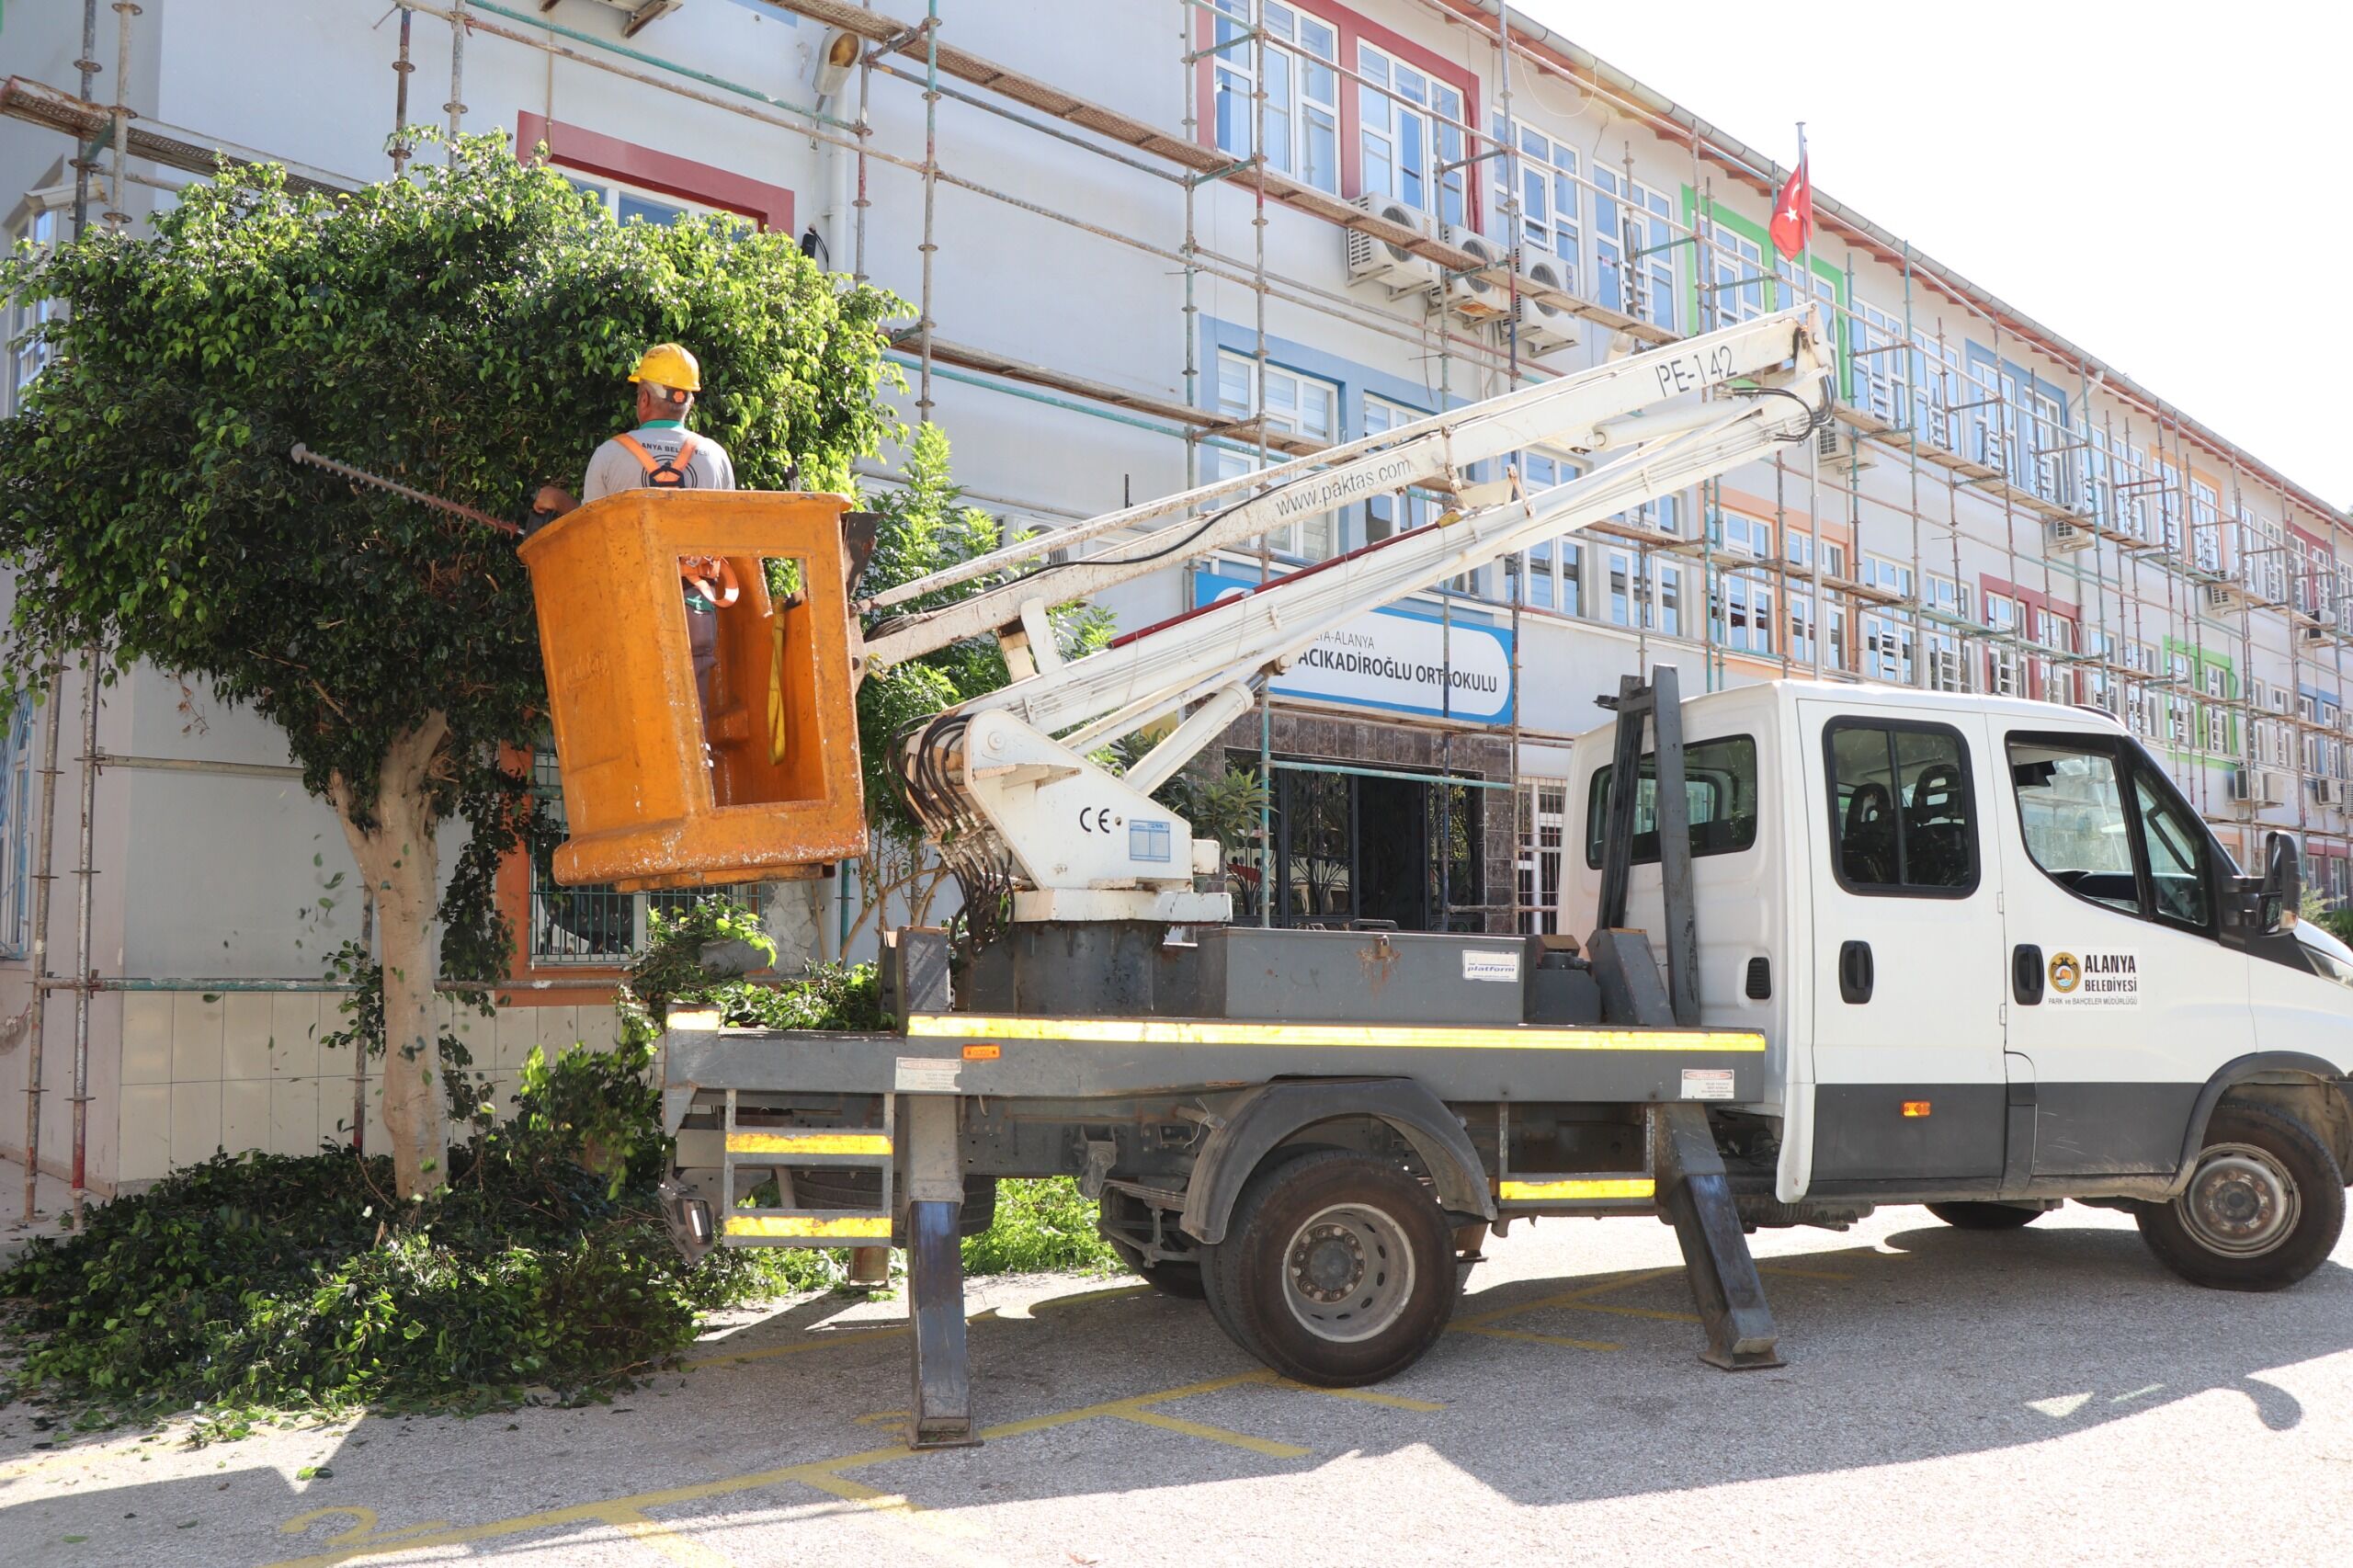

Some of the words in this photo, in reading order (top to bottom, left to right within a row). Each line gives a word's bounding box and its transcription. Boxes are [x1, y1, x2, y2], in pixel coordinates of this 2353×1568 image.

[1655, 346, 1737, 397] PE-142
[642, 442, 662, 450] ANYA
[1276, 459, 1411, 517] www.paktas.com
[1079, 807, 1110, 834] CE
[2085, 955, 2136, 973] ALANYA
[2085, 977, 2137, 992] BELEDİYESİ
